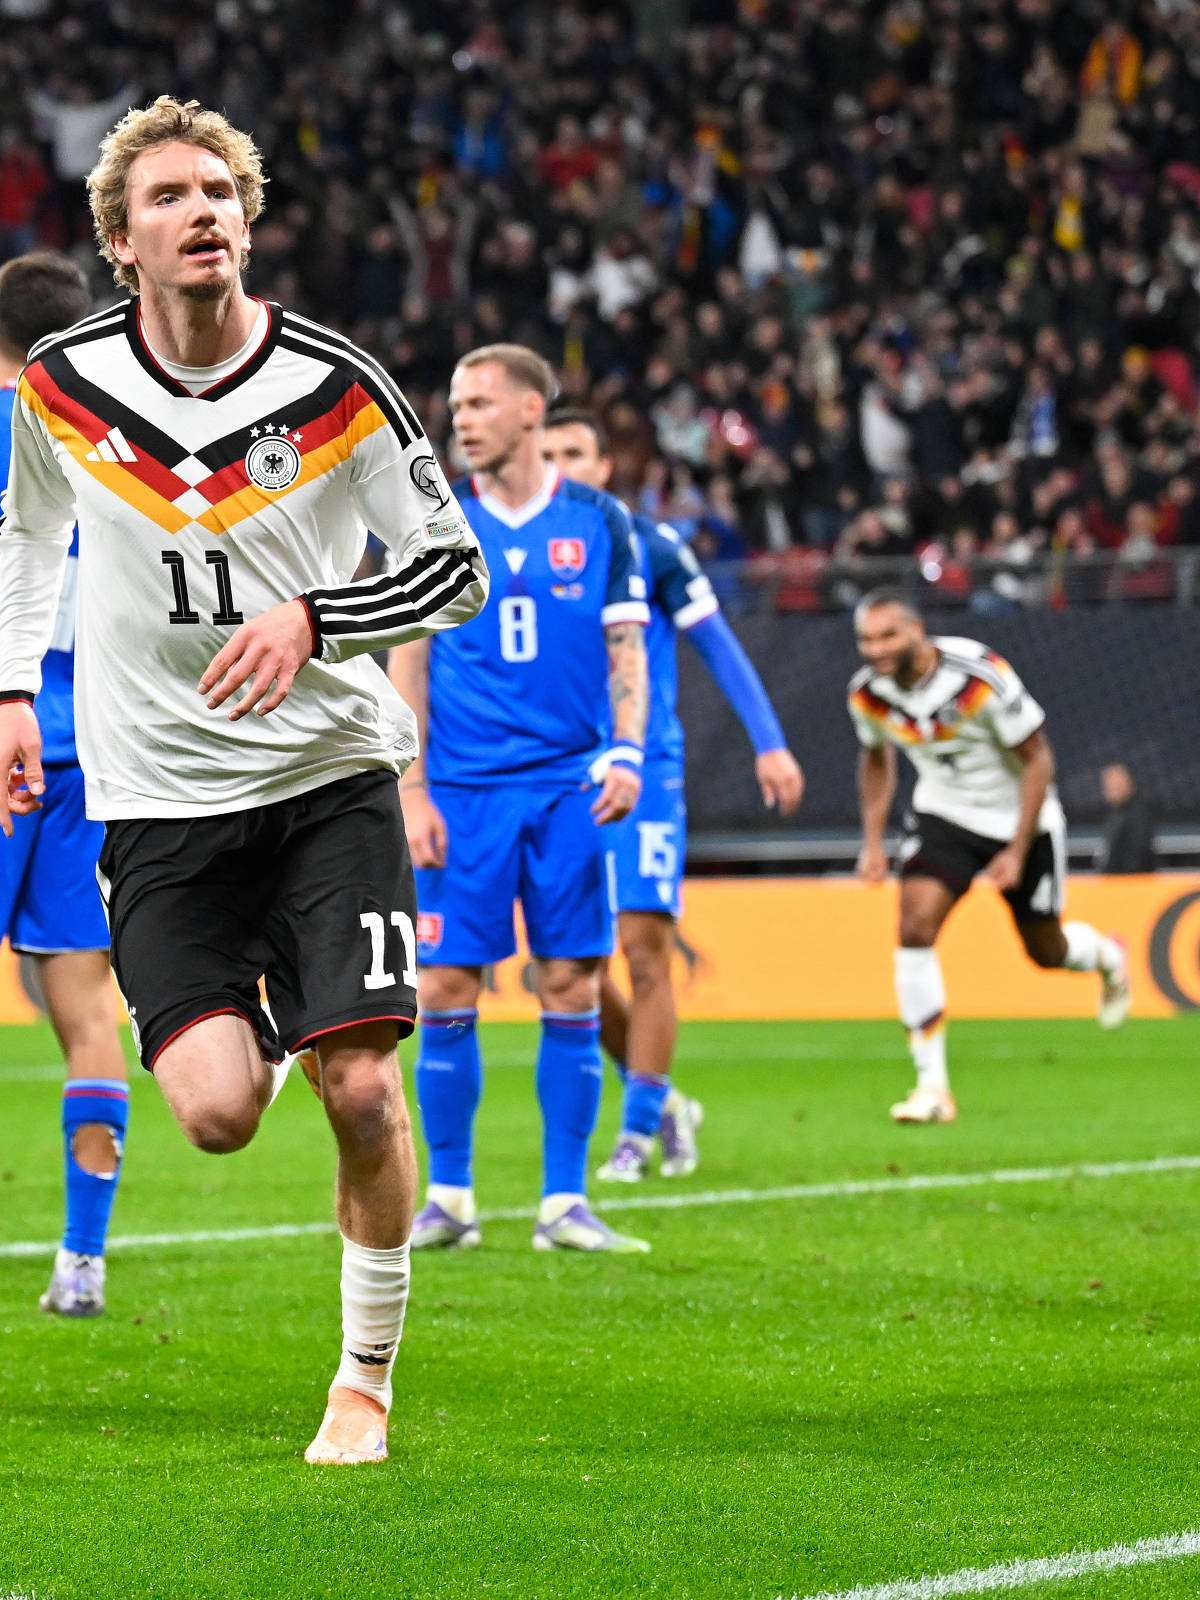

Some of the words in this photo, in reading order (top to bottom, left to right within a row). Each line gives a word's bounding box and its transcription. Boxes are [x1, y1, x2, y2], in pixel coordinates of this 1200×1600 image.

[161, 550, 244, 626] 11
[499, 596, 538, 662] 8
[636, 821, 676, 878] 15
[360, 911, 418, 989] 11
